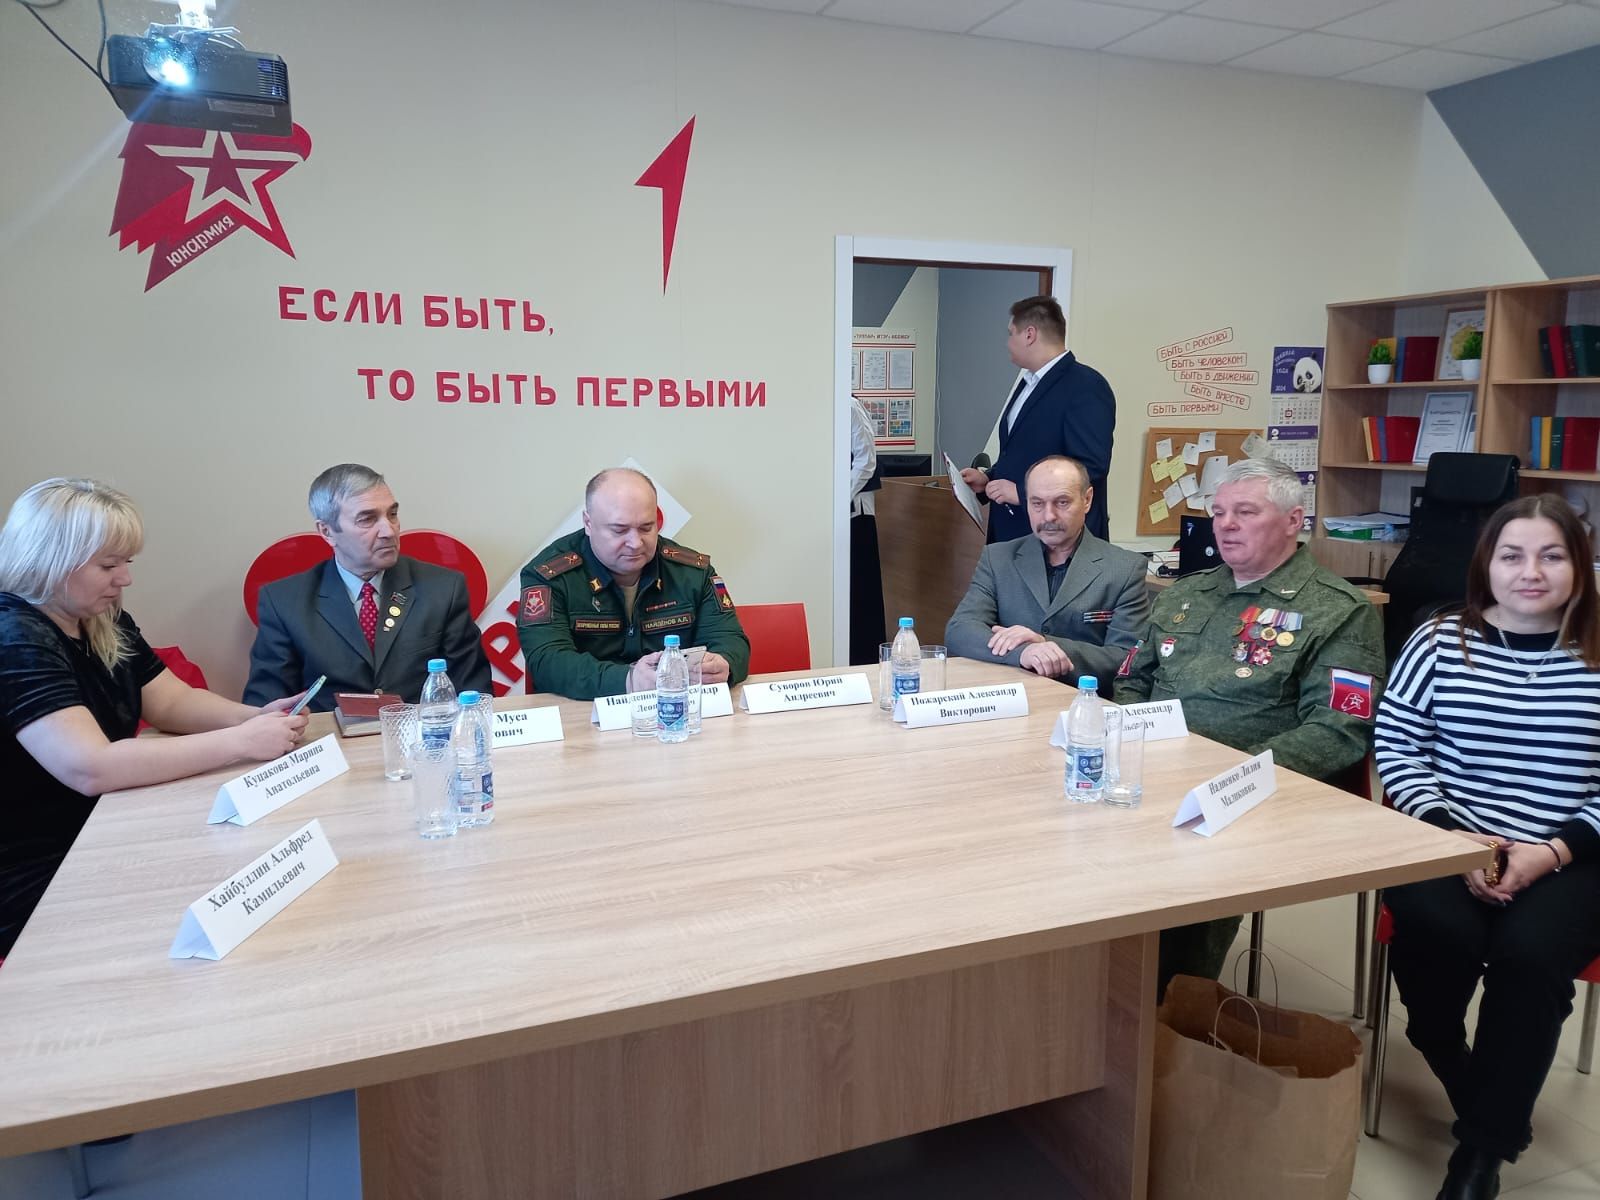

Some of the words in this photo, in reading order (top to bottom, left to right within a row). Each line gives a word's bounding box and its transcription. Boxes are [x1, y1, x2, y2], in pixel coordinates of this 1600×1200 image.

[278, 286, 401, 325] ЕСЛИ
[423, 295, 555, 337] БЫТЬ,
[1171, 359, 1195, 369] БЫТЬ
[1180, 370, 1203, 380] БЫТЬ
[357, 368, 415, 402] ТО
[436, 371, 557, 406] БЫТЬ
[576, 376, 767, 408] ПЕРВЫМИ
[1190, 384, 1212, 397] БЫТЬ
[1152, 404, 1178, 414] БЫТЬ
[769, 681, 812, 692] Суворов
[812, 677, 843, 687] Юрий
[784, 690, 836, 702] Андреевич
[911, 692, 966, 705] Пожарский
[968, 687, 1017, 700] Александр
[940, 705, 996, 718] Викторович
[1124, 703, 1173, 717] Александр
[496, 713, 528, 724] Муса
[288, 744, 324, 766] Марина
[265, 764, 320, 798] Анатольевна
[207, 862, 271, 912] Хайбуллин
[271, 830, 314, 867] Альфред
[241, 861, 306, 915] Камильевич
